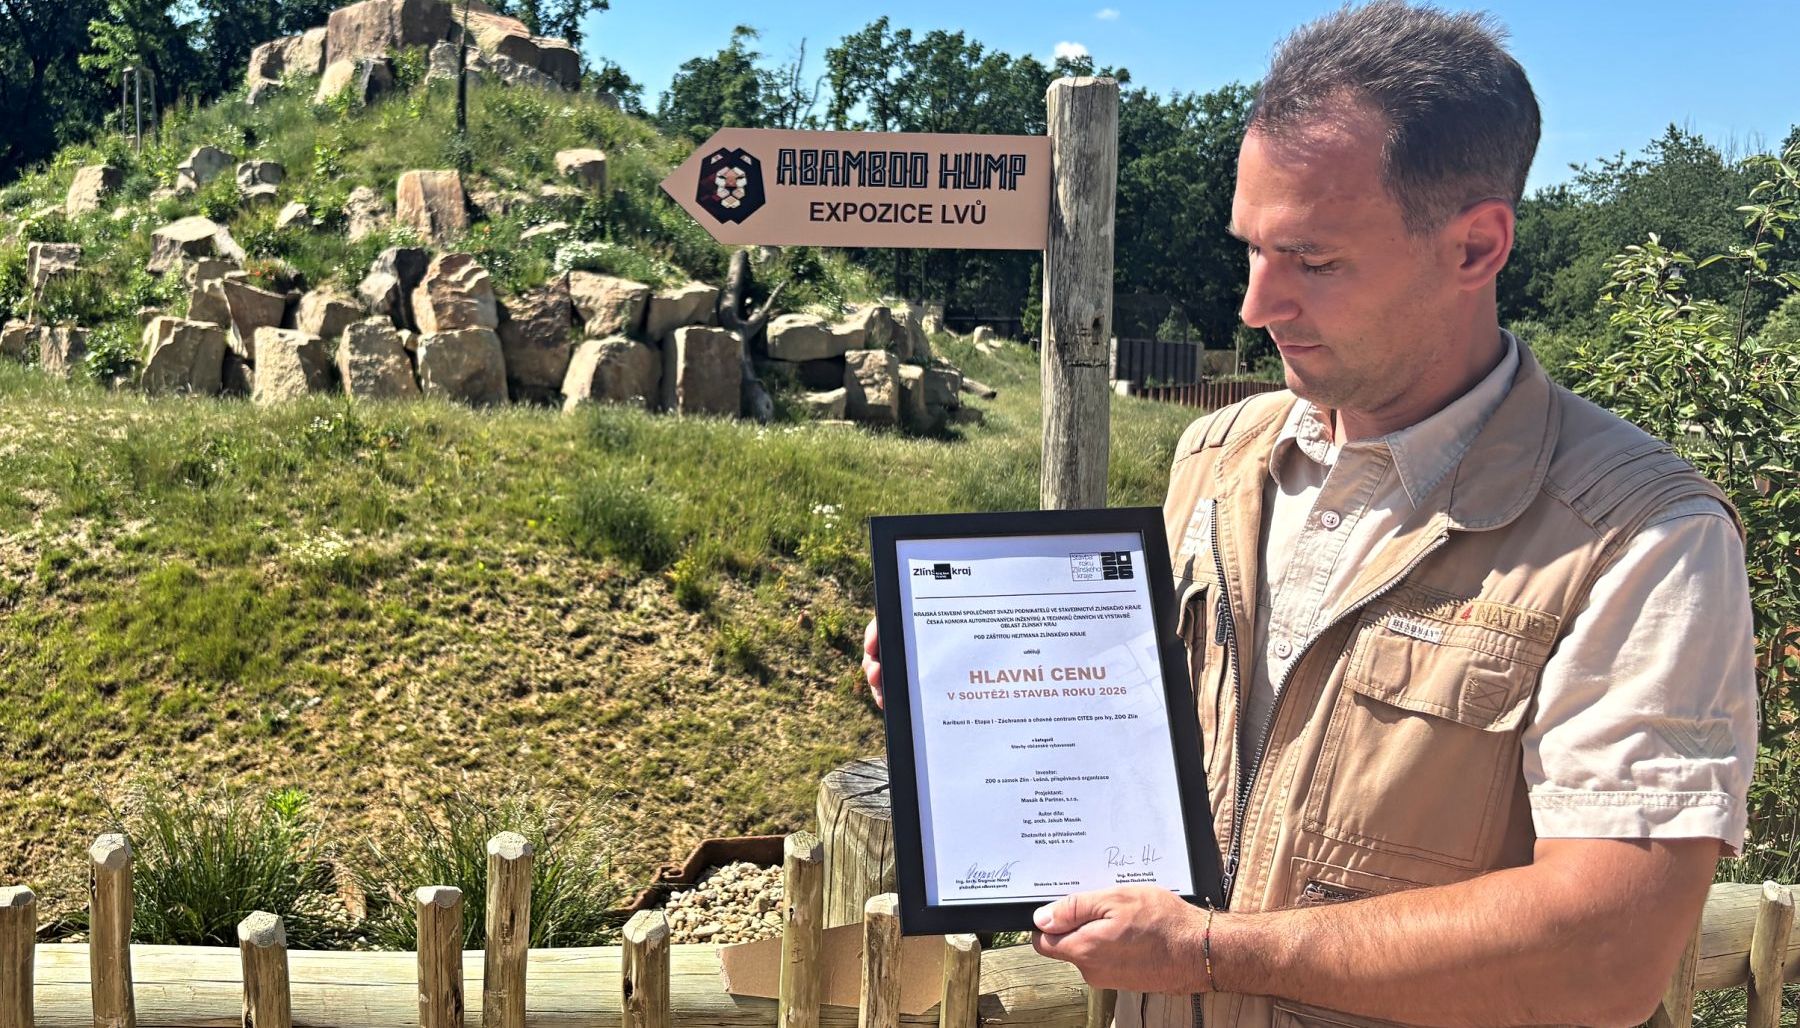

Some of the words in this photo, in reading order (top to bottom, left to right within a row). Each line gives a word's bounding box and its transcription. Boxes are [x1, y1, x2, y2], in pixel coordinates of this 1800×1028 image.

[776, 148, 928, 188] ABAMBOO
[939, 152, 1027, 191] HUMP
[810, 202, 933, 224] EXPOZICE
[941, 200, 986, 224] LVŮ
[952, 567, 971, 576] kraj
[1460, 604, 1474, 622] 4
[969, 665, 1044, 684] HLAVNÍ
[1050, 666, 1106, 681] CENU
[947, 692, 955, 700] V
[959, 689, 1009, 700] SOUTĚŽI
[1013, 689, 1058, 698] STAVBA
[1062, 687, 1096, 697] ROKU
[1099, 686, 1127, 695] 2026
